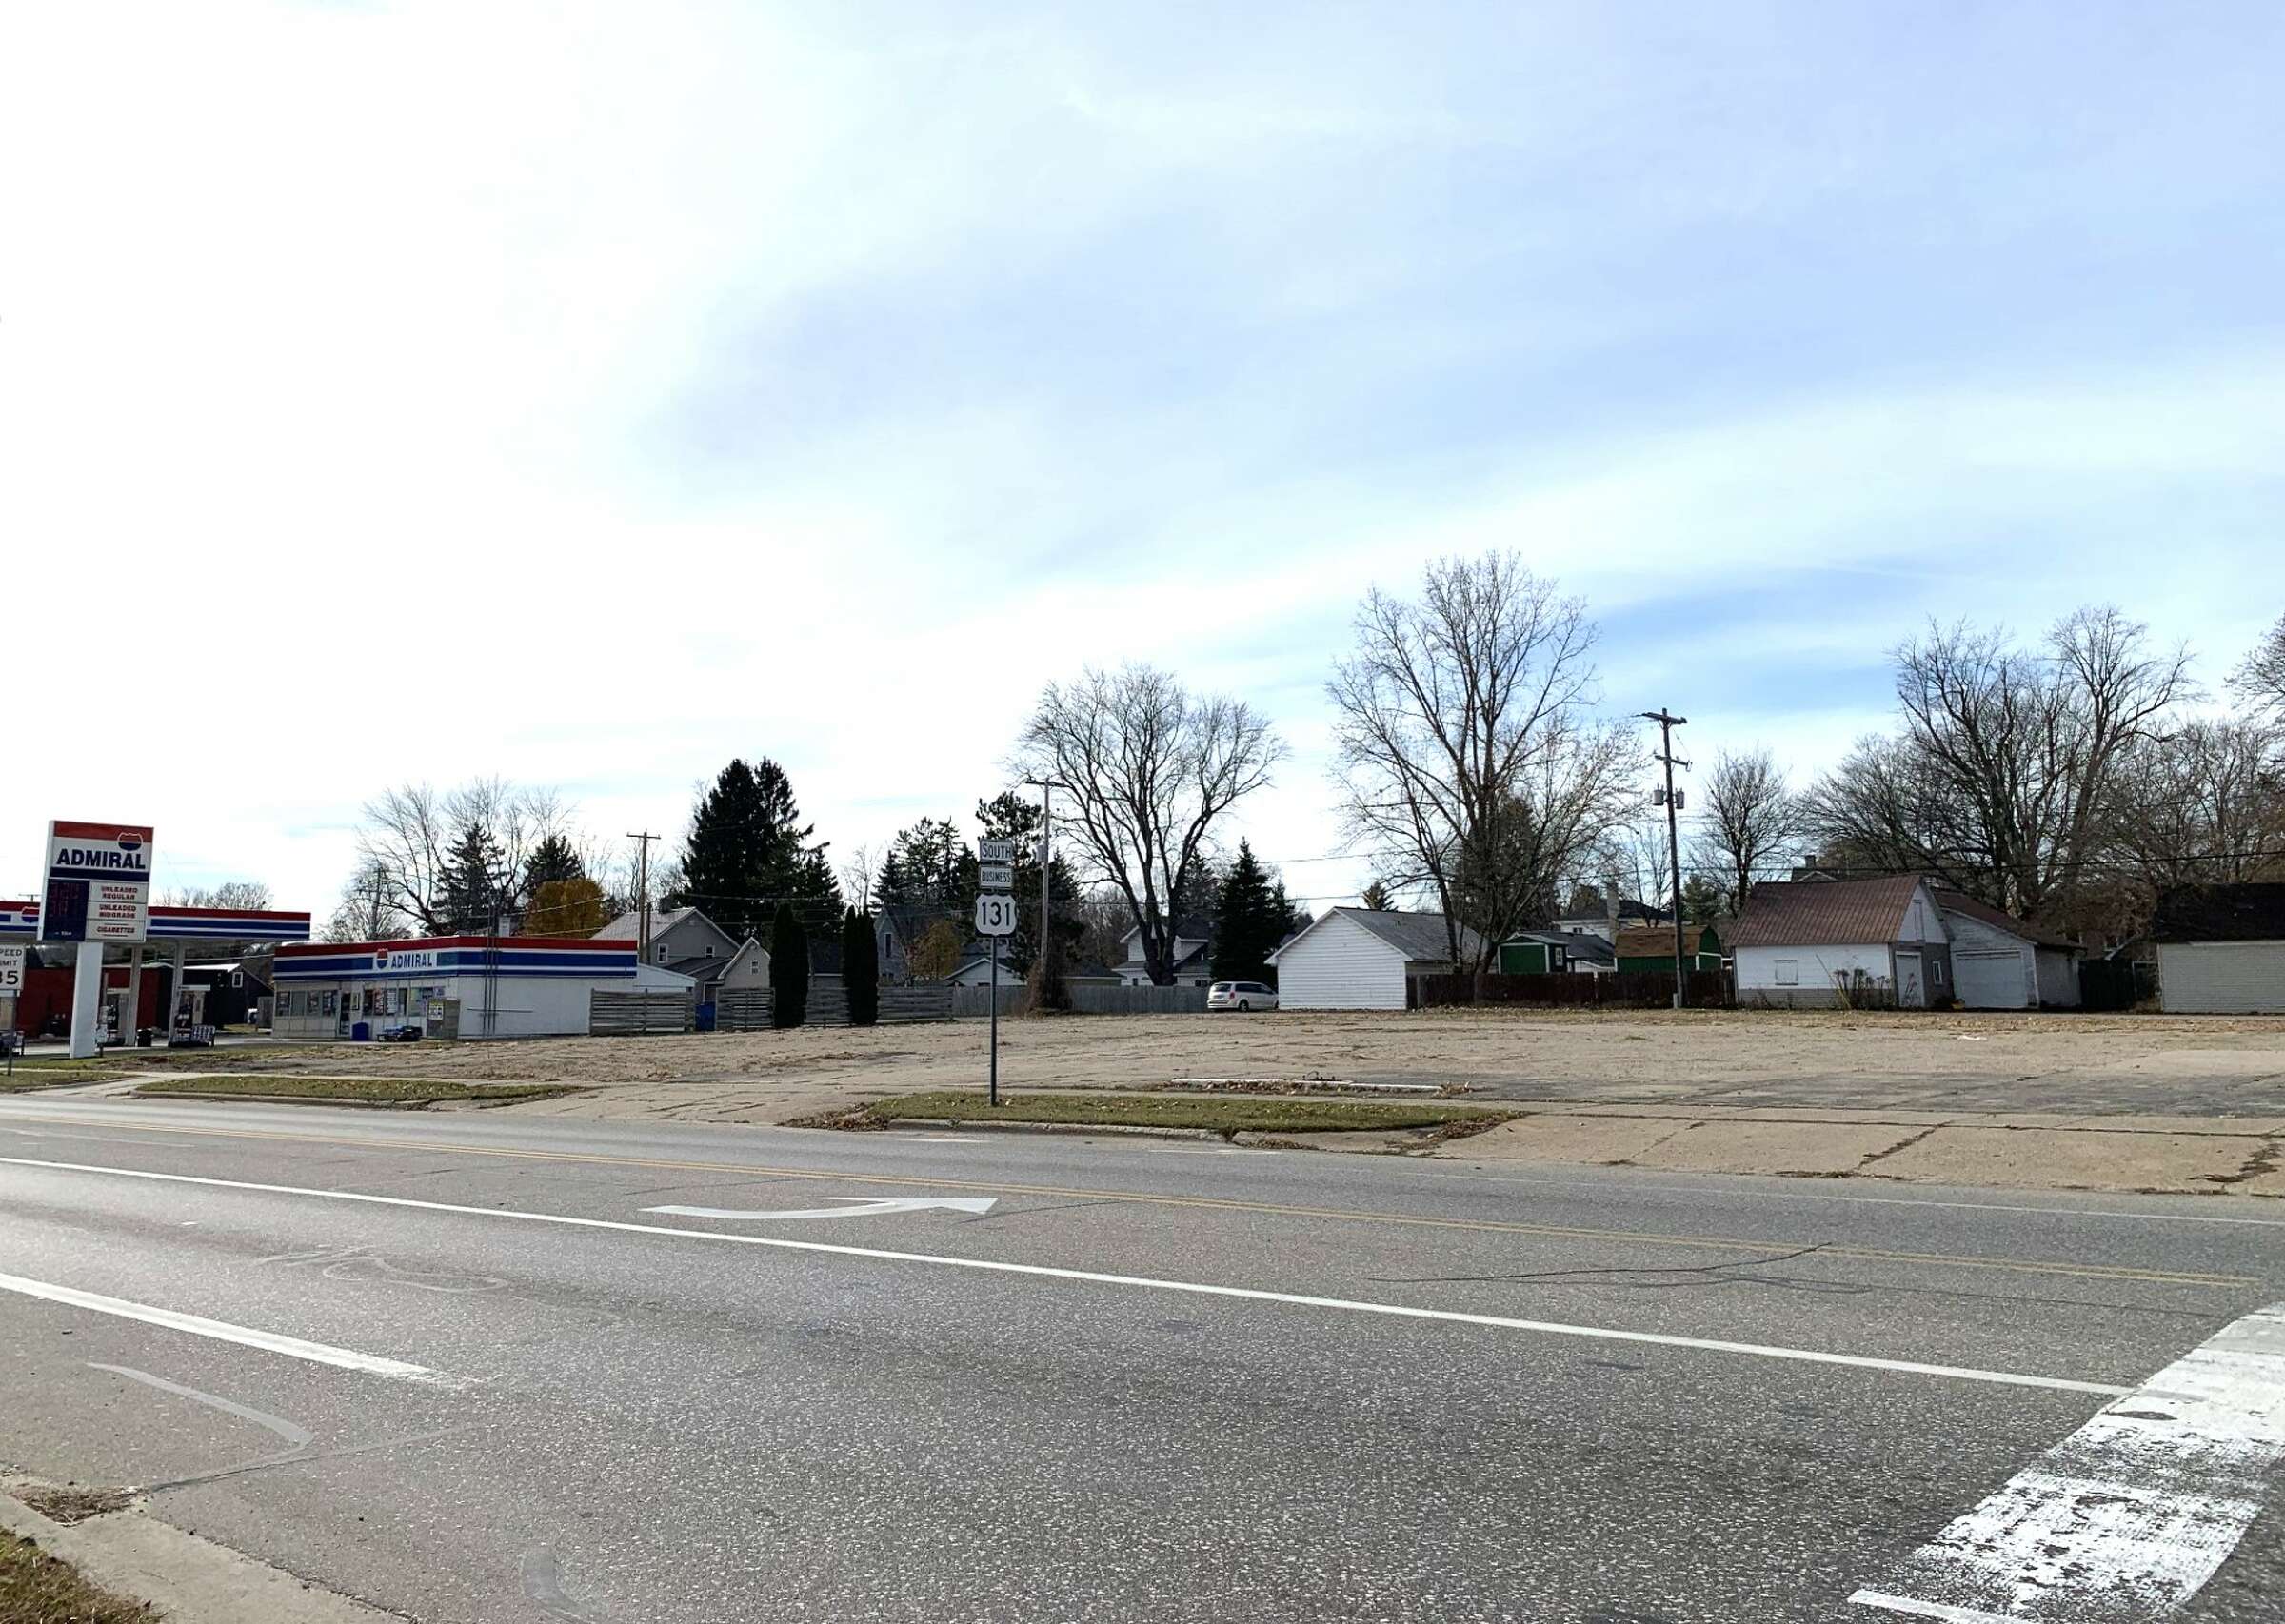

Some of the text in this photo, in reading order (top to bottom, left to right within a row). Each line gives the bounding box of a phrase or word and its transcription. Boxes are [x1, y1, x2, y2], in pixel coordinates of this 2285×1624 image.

[982, 843, 1011, 858] SOUTH
[56, 848, 146, 869] ADMIRAL
[982, 870, 1011, 883] BUSINESS
[982, 901, 1010, 926] 131
[391, 953, 432, 967] ADMIRAL
[0, 971, 18, 984] 5
